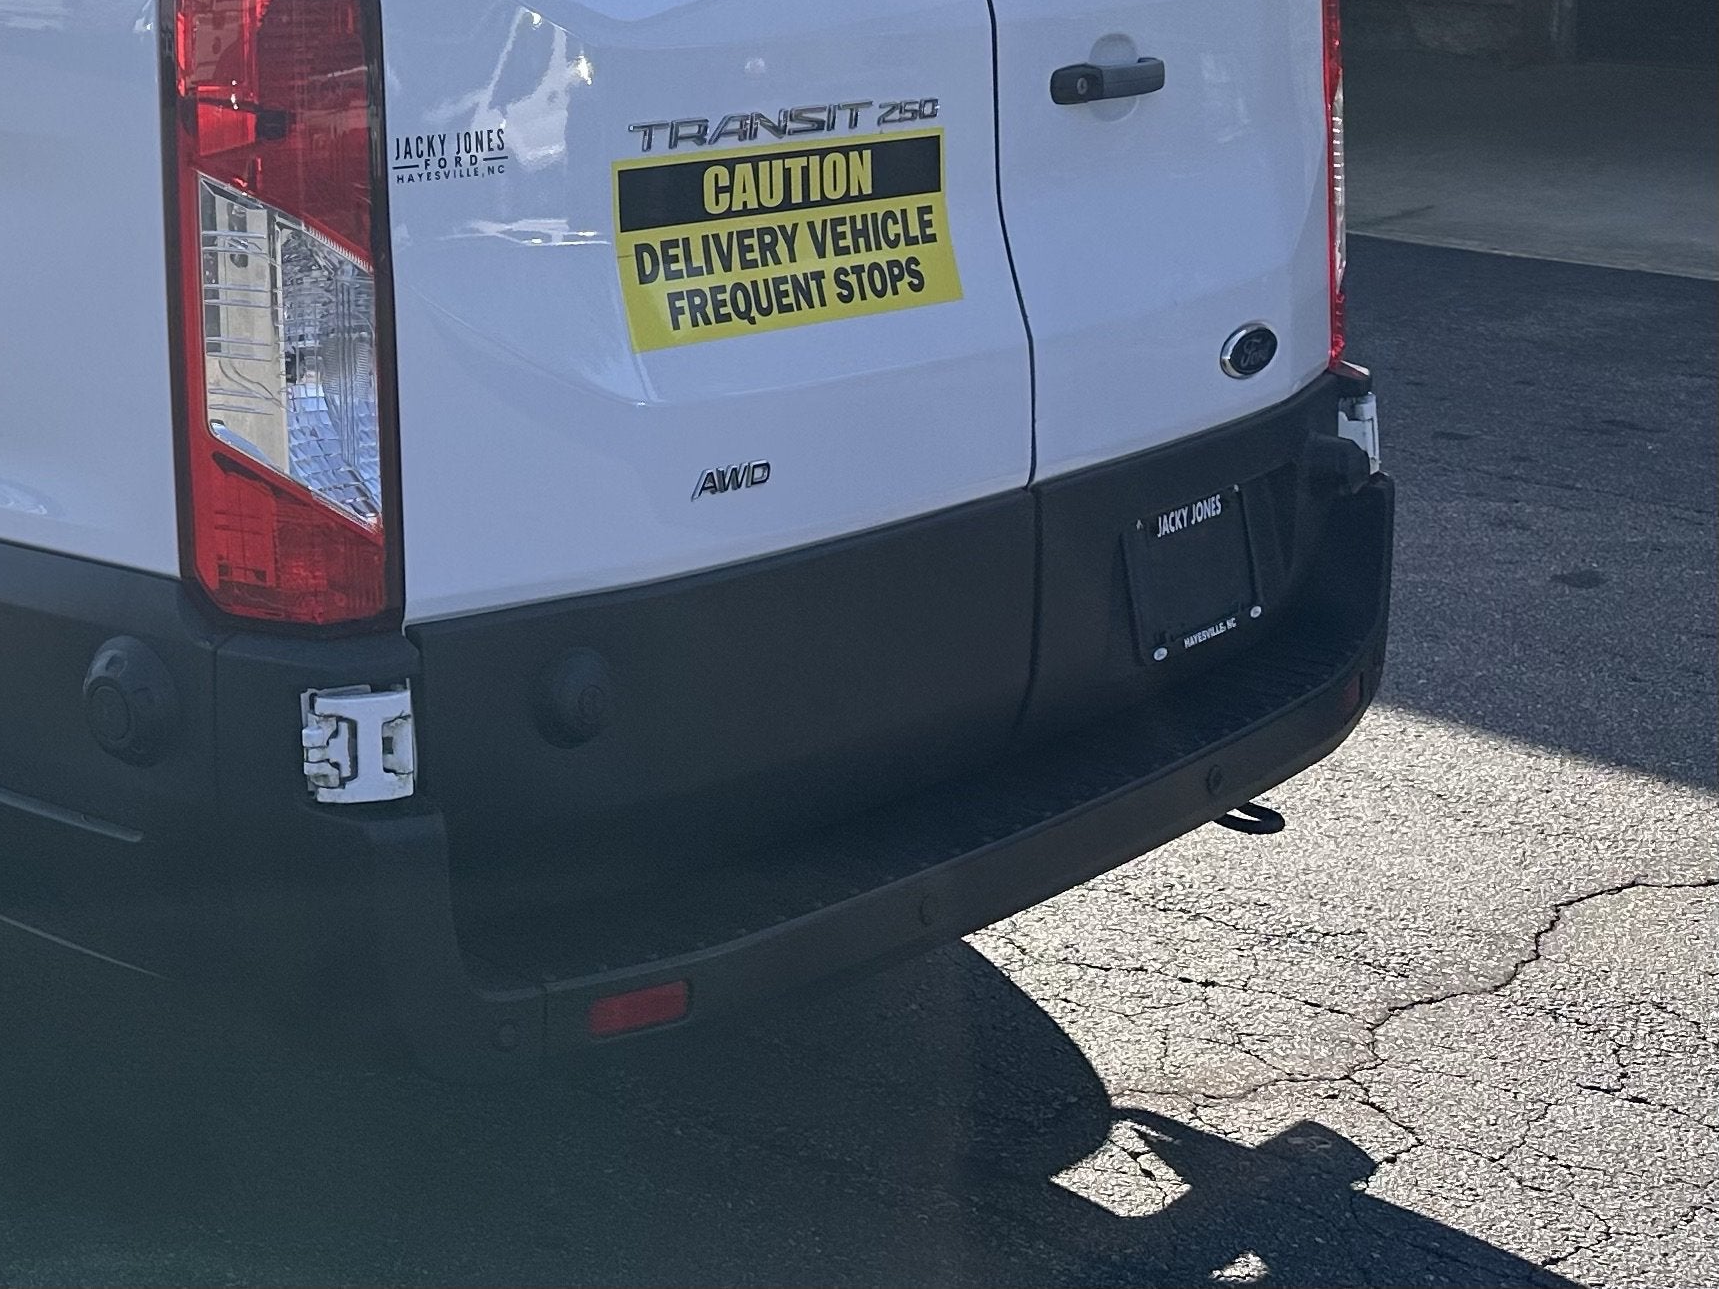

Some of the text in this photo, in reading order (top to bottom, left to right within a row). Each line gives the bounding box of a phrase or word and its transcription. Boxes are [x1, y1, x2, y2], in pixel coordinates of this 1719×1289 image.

[394, 128, 506, 161] JACKY JONES
[628, 98, 941, 152] TRANSIT 250
[424, 154, 479, 171] FORD
[702, 149, 873, 215] CAUTION
[634, 205, 938, 285] DELIVERY VEHICLE
[667, 256, 926, 331] FREQUENT STOPS
[690, 459, 771, 502] AWD
[1156, 494, 1222, 538] JACKY JONES
